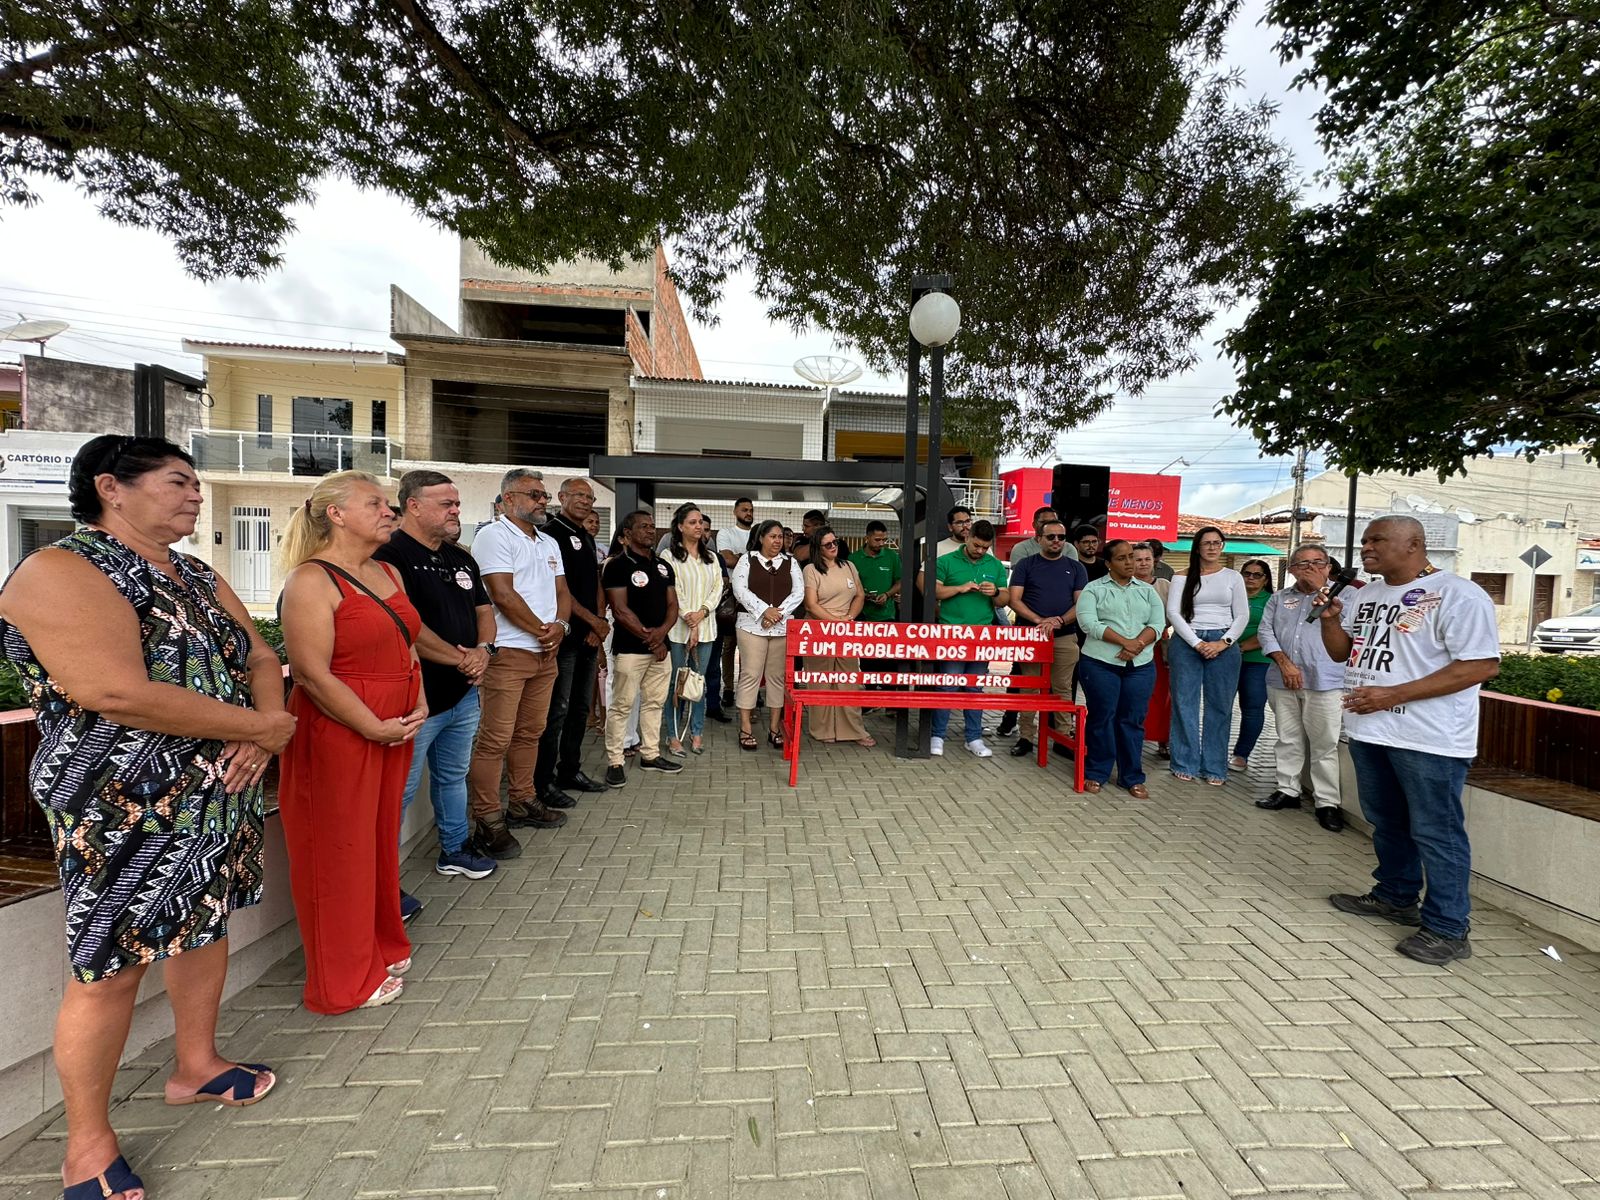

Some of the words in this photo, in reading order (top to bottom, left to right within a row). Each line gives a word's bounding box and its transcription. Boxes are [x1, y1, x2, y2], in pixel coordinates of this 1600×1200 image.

[7, 453, 62, 464] CARTÓRIO
[65, 456, 75, 464] D
[1121, 499, 1163, 511] MENOS
[1119, 522, 1166, 530] TRABALHADOR
[799, 621, 812, 635] A
[820, 621, 899, 637] VIOLÊNCIA
[906, 624, 975, 639] CONTRA
[980, 627, 994, 640] A
[996, 627, 1049, 641] MULHER
[799, 636, 809, 655] É
[813, 641, 836, 655] UM
[842, 642, 929, 658] PROBLEMA
[936, 645, 967, 659] DOS
[975, 646, 1035, 661] HOMENS
[1358, 649, 1394, 673] PIR
[794, 671, 858, 684] LUTAMOS
[863, 673, 892, 685] PELO
[897, 673, 968, 686] FEMINICÍDIO
[976, 675, 1011, 687] ZERO
